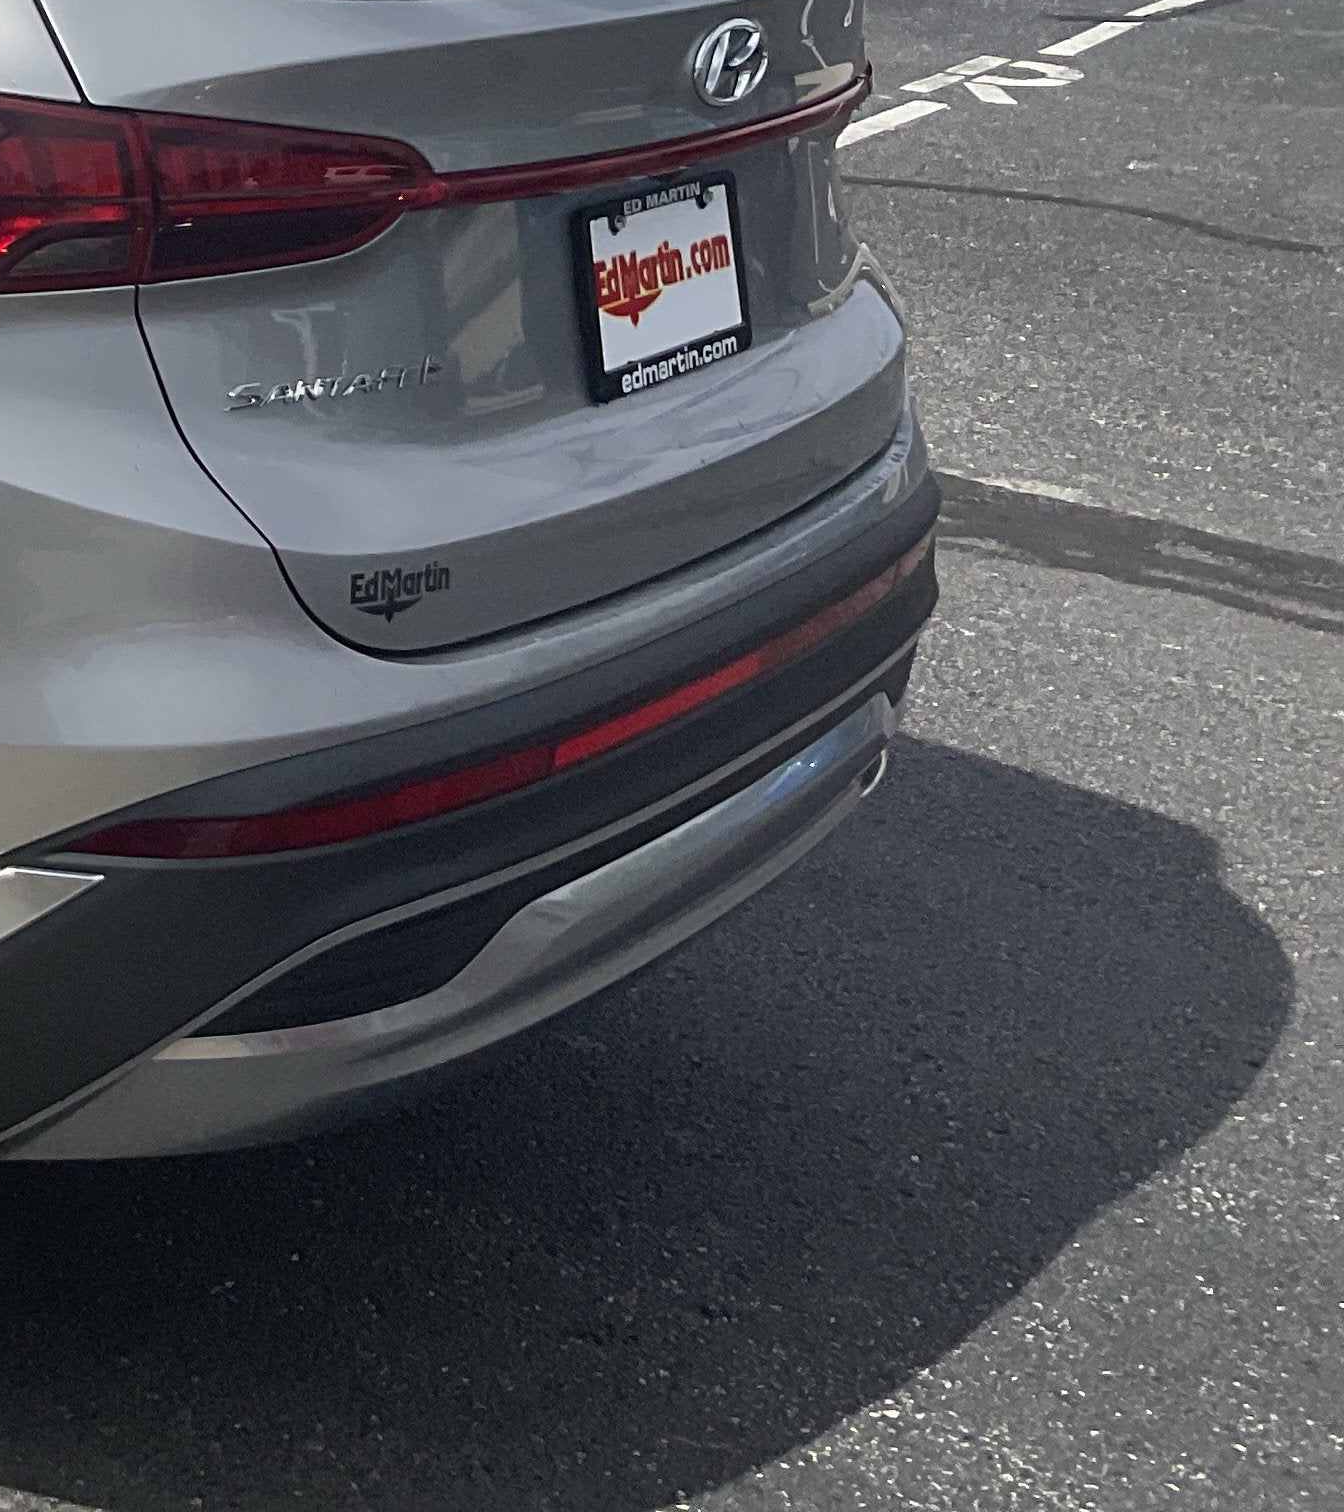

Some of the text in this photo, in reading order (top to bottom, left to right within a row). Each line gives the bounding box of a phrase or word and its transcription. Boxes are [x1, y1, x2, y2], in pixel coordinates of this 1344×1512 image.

[623, 182, 702, 214] ED MARTIN
[593, 234, 731, 307] EdMartin.com
[621, 336, 739, 394] edmartin.com
[350, 560, 451, 605] EdMartin
